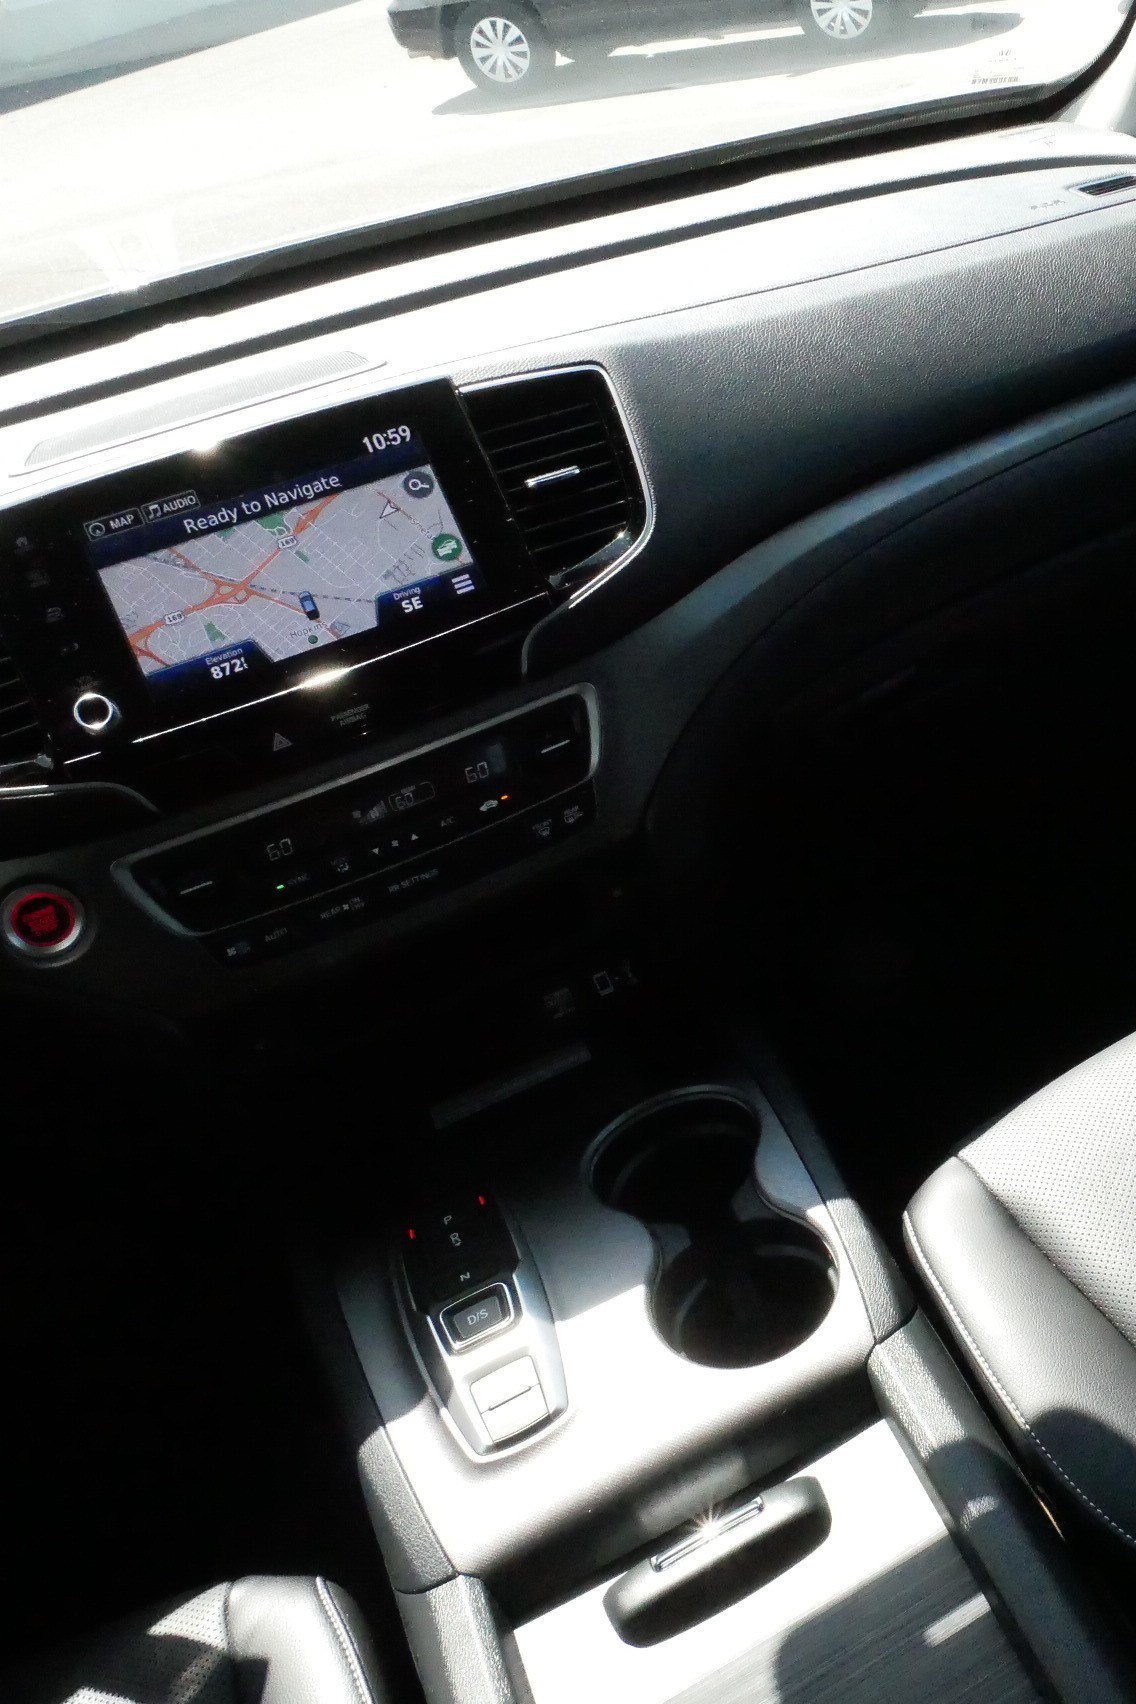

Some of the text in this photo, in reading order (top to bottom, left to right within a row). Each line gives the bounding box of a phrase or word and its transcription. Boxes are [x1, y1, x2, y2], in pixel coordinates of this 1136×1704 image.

[361, 424, 412, 454] 10:59
[162, 494, 197, 515] AUDIO
[182, 472, 341, 536] Ready to Navigate
[108, 513, 135, 531] MAP
[278, 535, 297, 549] 169
[392, 586, 422, 601] Driving
[401, 596, 424, 613] SE
[166, 612, 184, 625] 169
[289, 620, 328, 641] Hopkins
[204, 648, 243, 666] Elevation
[464, 760, 490, 785] 60
[265, 837, 293, 863] 60
[442, 1214, 453, 1227] P
[459, 1271, 471, 1283] N
[466, 1309, 489, 1326] D/S
